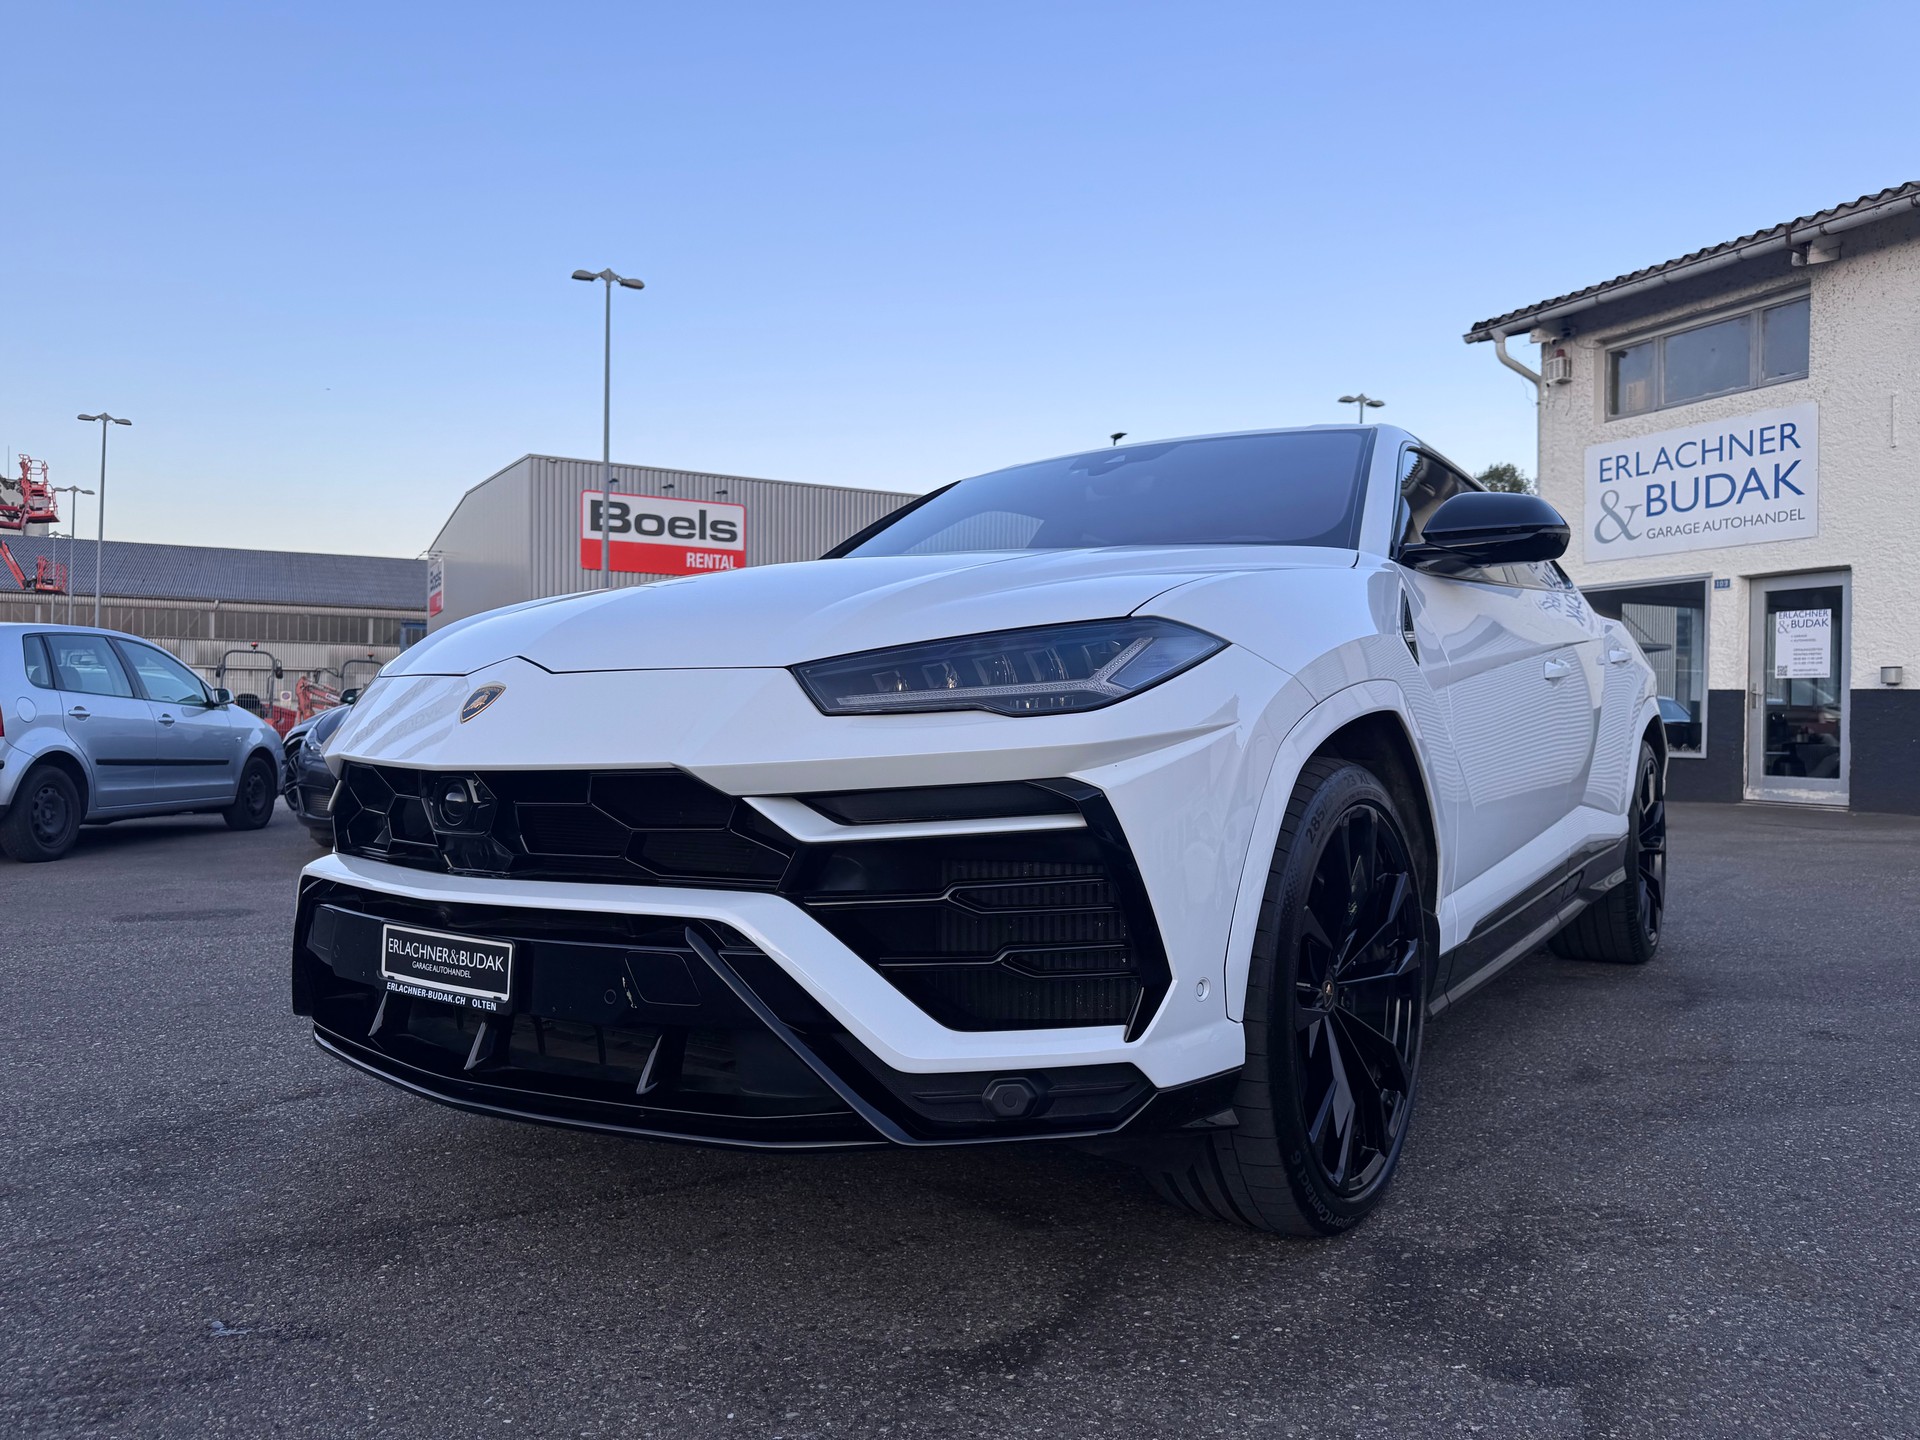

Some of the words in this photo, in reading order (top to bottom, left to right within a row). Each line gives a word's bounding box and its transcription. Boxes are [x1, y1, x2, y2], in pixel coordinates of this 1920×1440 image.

[1599, 422, 1802, 484] ERLACHNER
[1594, 489, 1643, 545] &
[1645, 459, 1805, 517] BUDAK
[590, 499, 738, 543] Boels
[1646, 521, 1700, 540] GARAGE
[1702, 508, 1806, 533] AUTOHANDEL
[685, 551, 737, 570] RENTAL
[1778, 609, 1829, 620] ERLACHNER
[1791, 618, 1829, 629] BUDAK
[411, 960, 433, 972] GARAGE
[432, 965, 472, 979] AUTOHANDEL
[386, 981, 466, 1006] ERLACHNER-BUDAK.CH
[471, 998, 497, 1011] OLTEN
